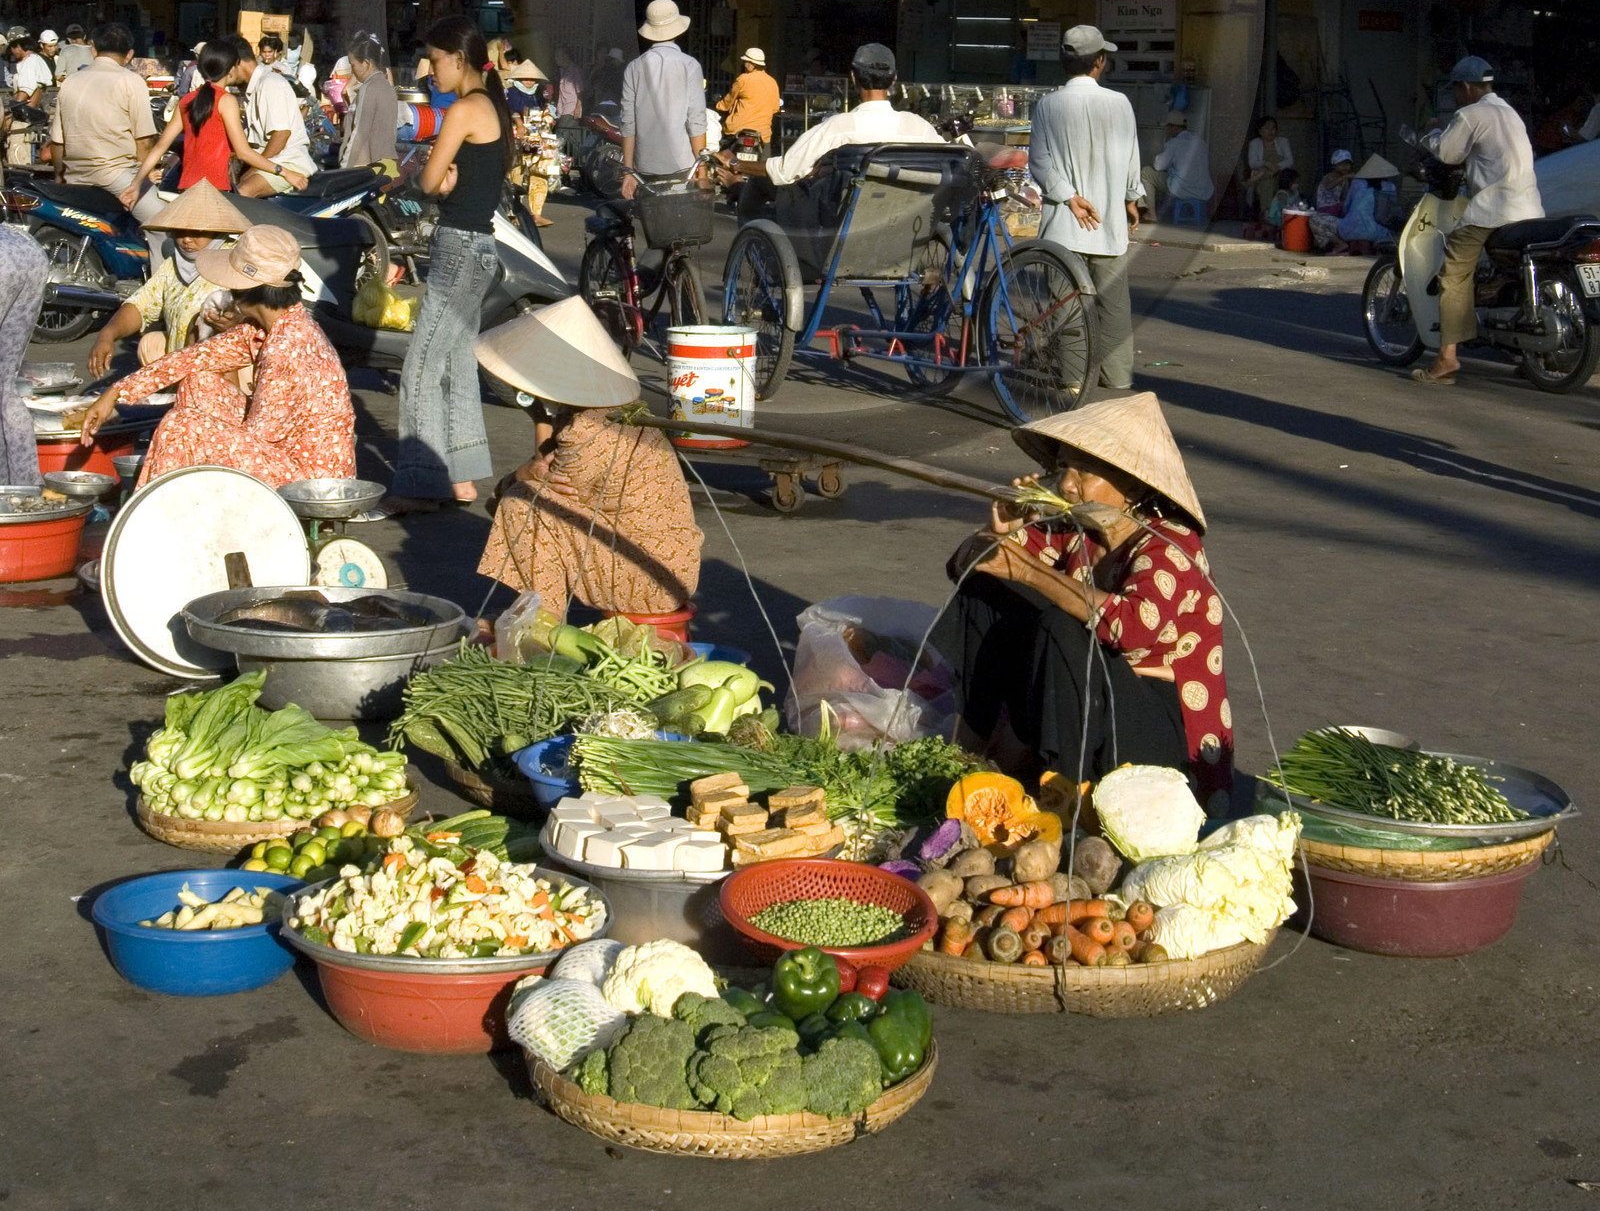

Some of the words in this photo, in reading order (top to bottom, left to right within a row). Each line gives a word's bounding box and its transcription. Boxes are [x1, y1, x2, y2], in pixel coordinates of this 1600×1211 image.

[1117, 5, 1138, 16] Kim
[1142, 5, 1163, 17] Nga
[1583, 266, 1600, 279] 51-
